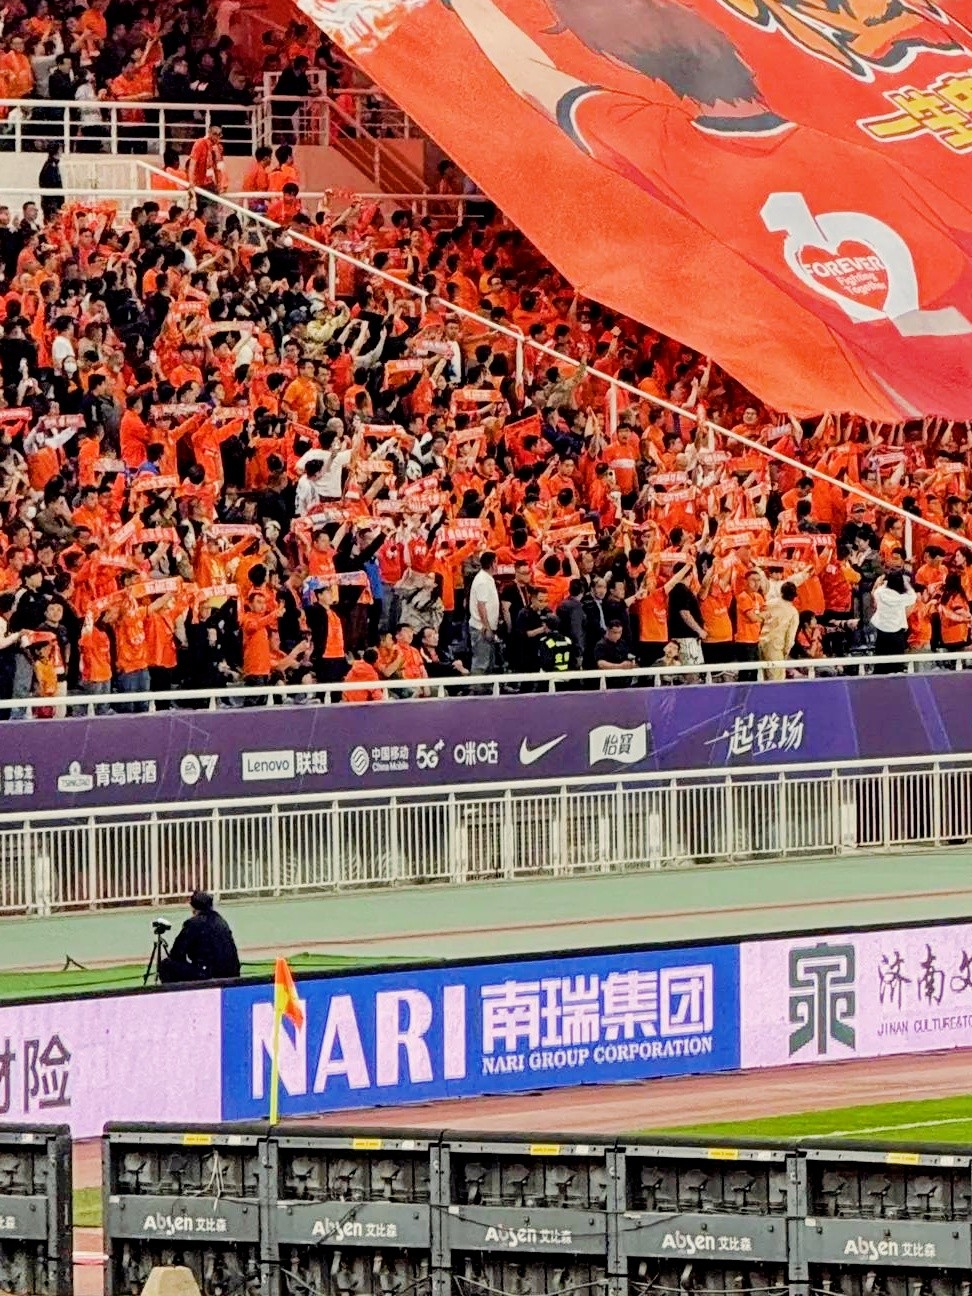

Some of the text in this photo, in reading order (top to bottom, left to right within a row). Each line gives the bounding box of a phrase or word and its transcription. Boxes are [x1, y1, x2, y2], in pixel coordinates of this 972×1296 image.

[802, 255, 887, 278] FOREVER
[704, 710, 805, 760] 一起登场
[371, 746, 410, 762] 中国移动
[246, 750, 328, 776] Lenovo 联想
[480, 963, 714, 1054] 南瑞集团
[877, 1021, 909, 1037] JINAN
[251, 984, 467, 1100] NARI
[482, 1036, 713, 1075] NARI GROUP CORPORATION
[196, 1218, 228, 1233] 艾比森
[365, 1222, 398, 1239] 艾比森
[539, 1230, 573, 1245] 艾比森
[717, 1236, 753, 1252] 艾比森
[901, 1242, 936, 1259] 艾比森
